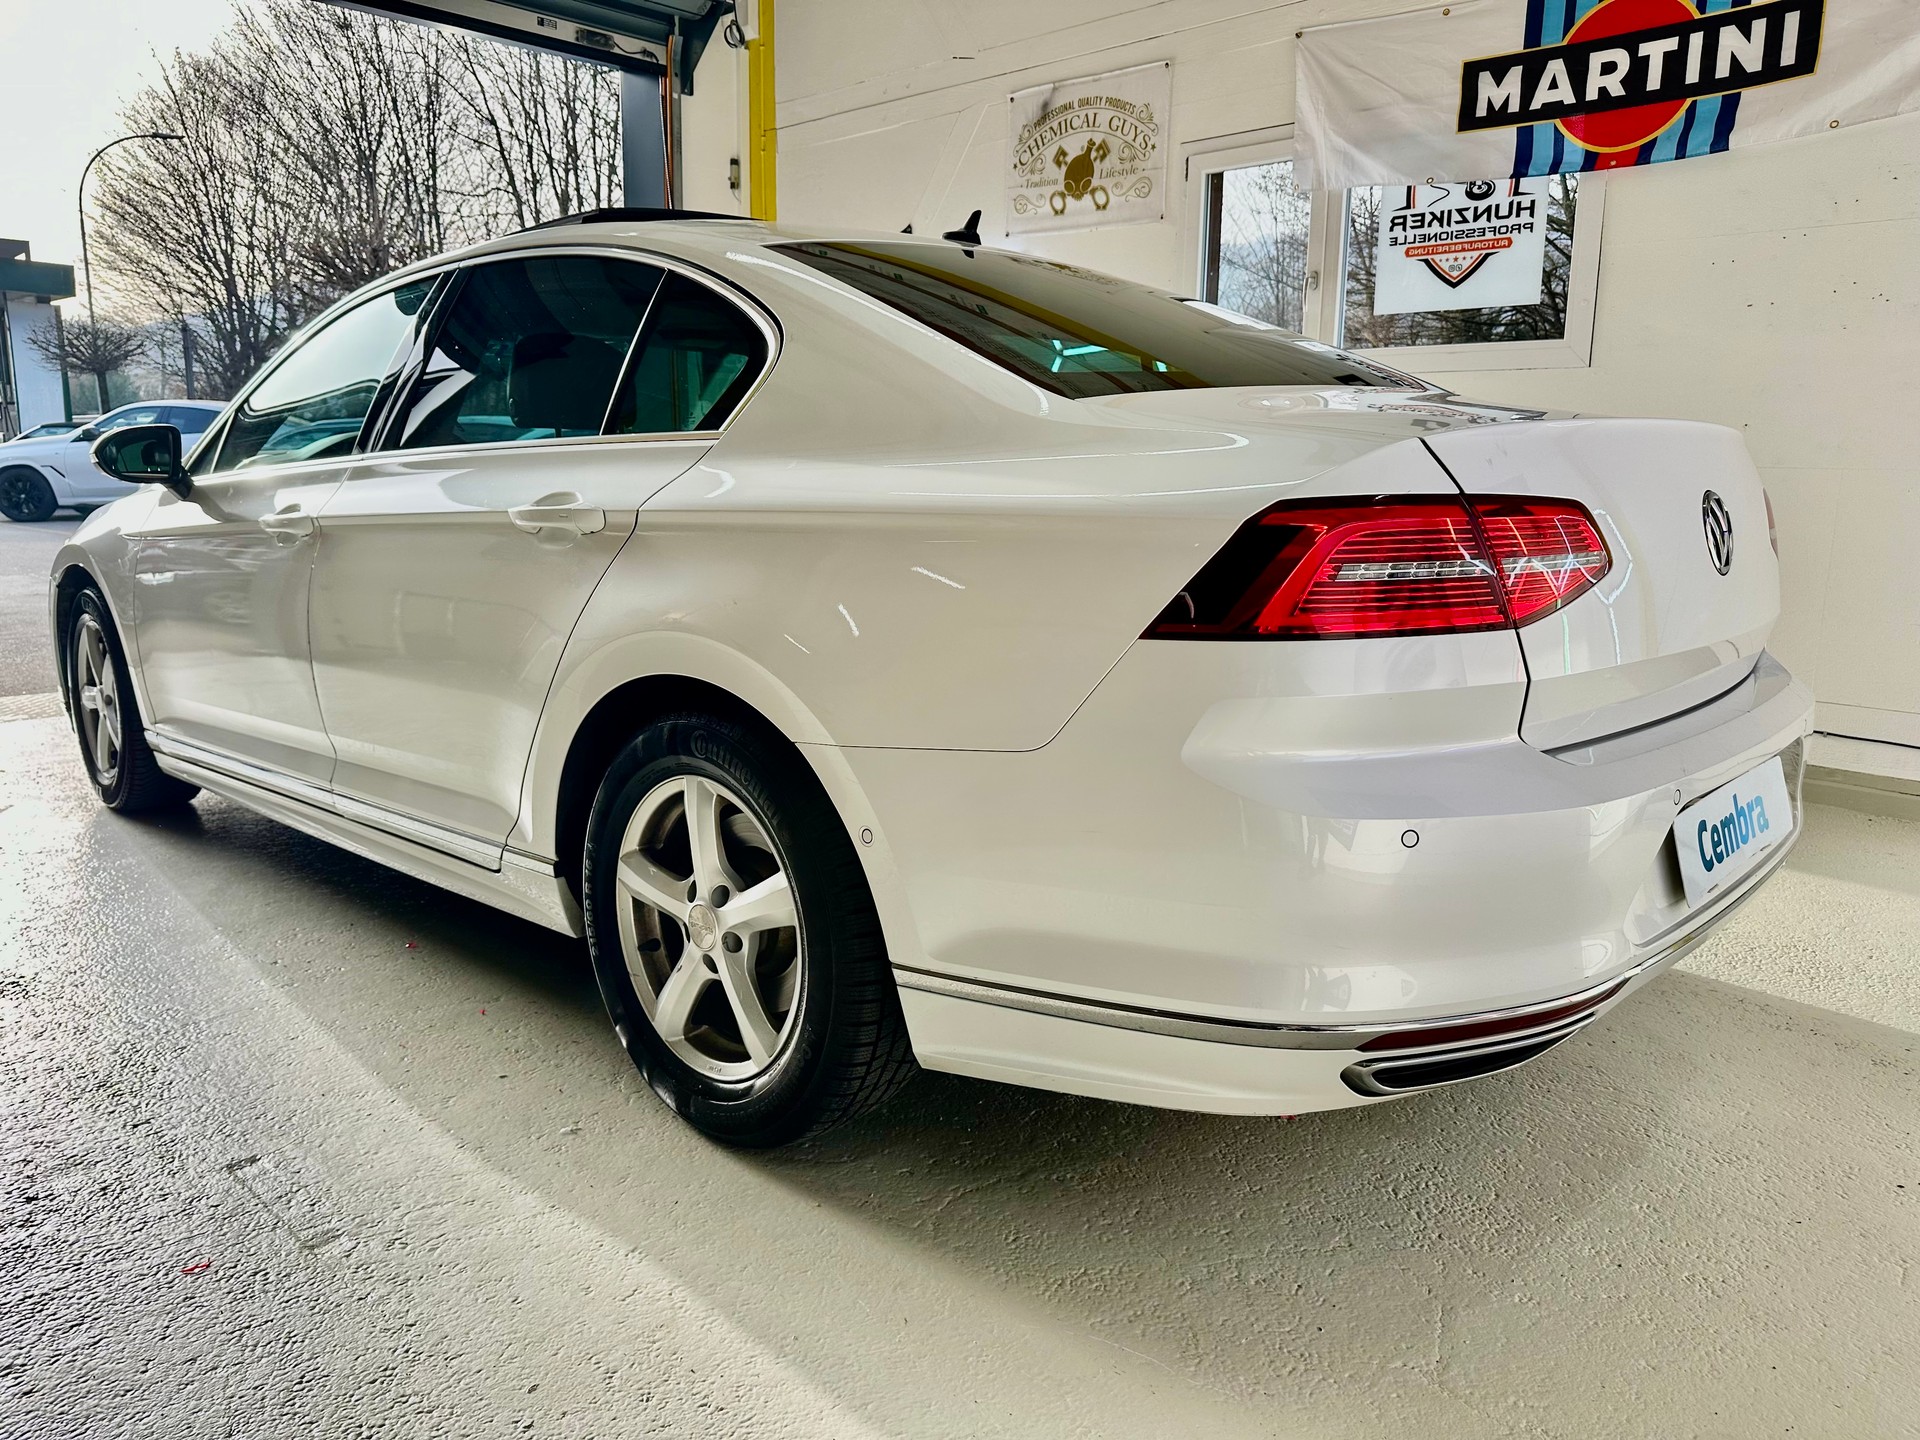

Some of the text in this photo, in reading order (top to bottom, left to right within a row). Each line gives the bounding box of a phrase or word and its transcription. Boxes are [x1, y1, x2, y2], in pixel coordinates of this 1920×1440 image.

[1475, 10, 1801, 118] MARTINI
[1033, 95, 1137, 131] PROFESSIONAL QUALITY PRODUCTS
[1018, 112, 1151, 167] CHEMICAL GUYS
[1024, 177, 1059, 190] Tradition
[1099, 165, 1139, 180] Lifestyle
[1697, 793, 1769, 873] Cembra
